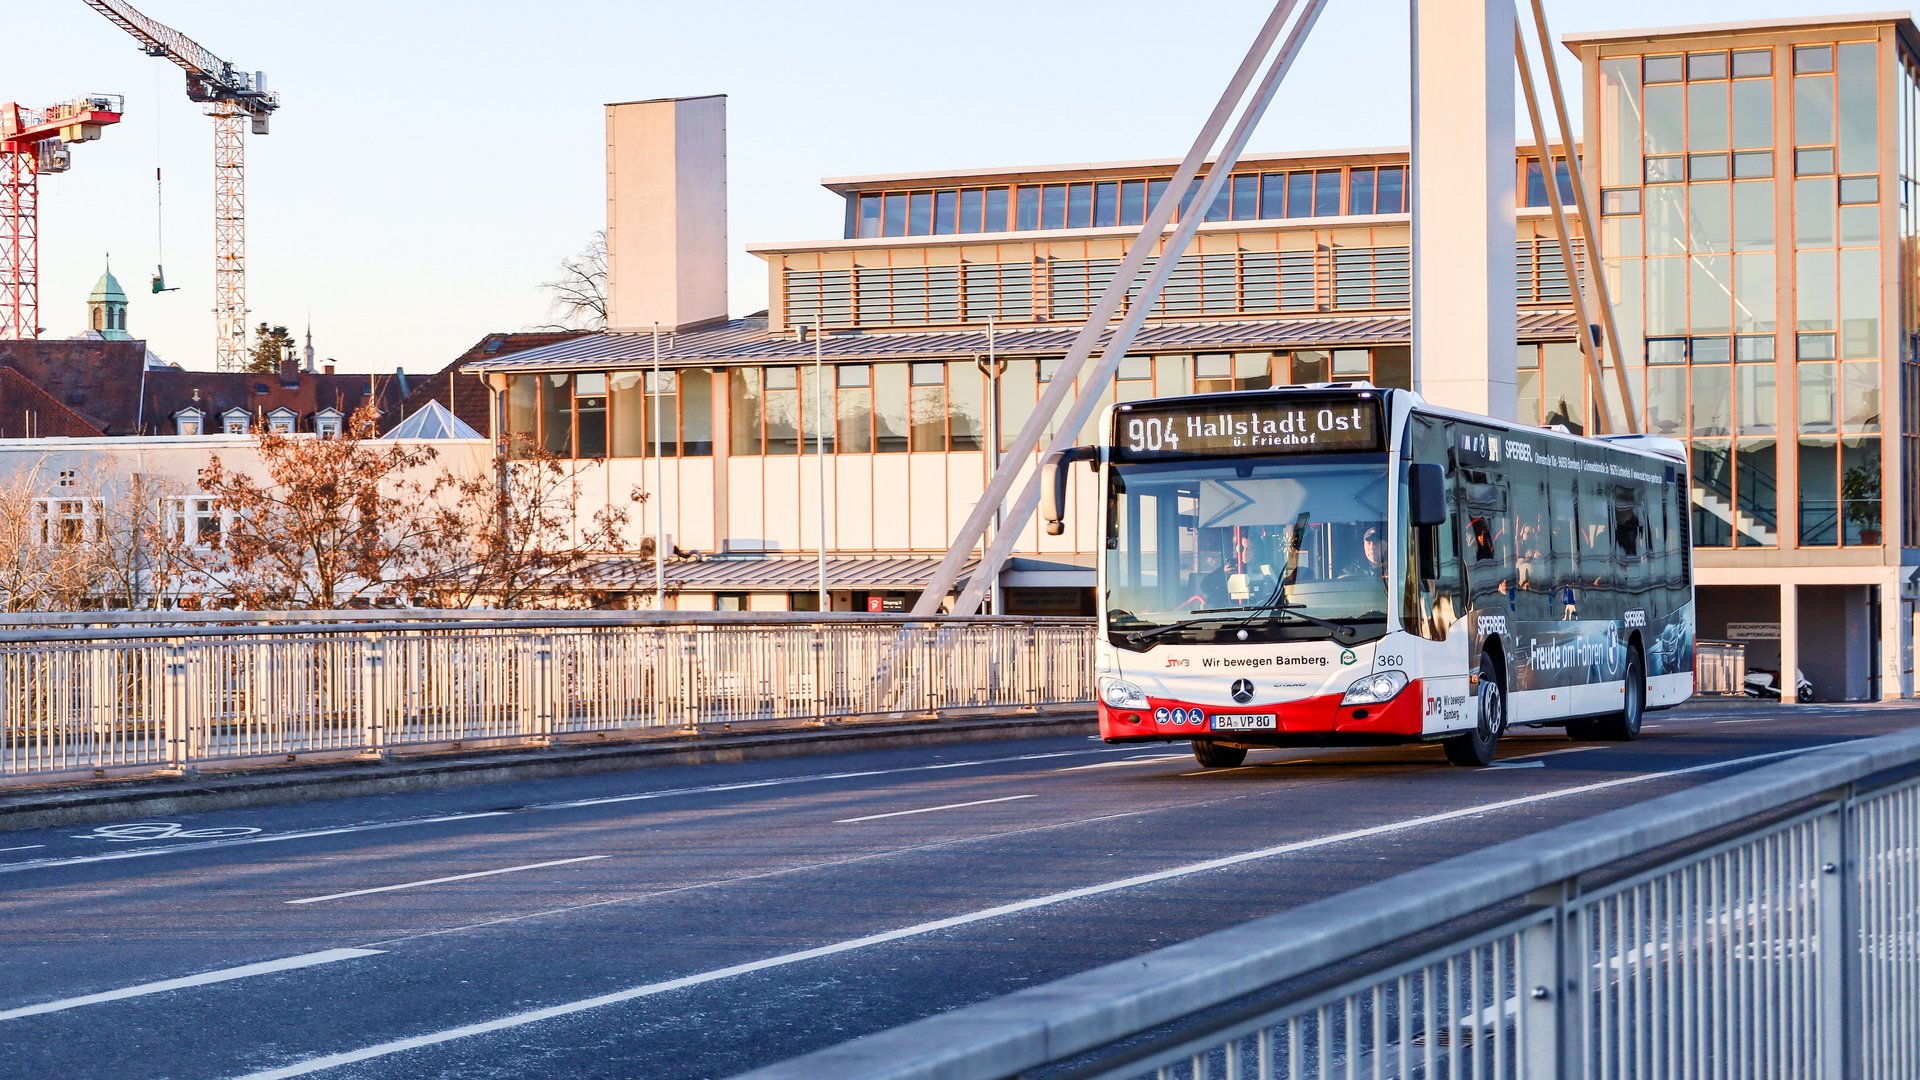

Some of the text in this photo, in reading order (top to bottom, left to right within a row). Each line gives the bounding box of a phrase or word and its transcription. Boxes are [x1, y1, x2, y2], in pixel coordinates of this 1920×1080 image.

[1129, 408, 1362, 452] 904 Hallstadt Ost
[1233, 432, 1316, 447] ü. Friedhof
[1505, 440, 1533, 463] SPERBER
[1477, 615, 1507, 636] SPERBER
[1624, 610, 1646, 626] SPERBER
[1378, 655, 1404, 666] 360
[1530, 635, 1603, 671] Freude am Fahren
[1202, 658, 1220, 667] Wir
[1224, 658, 1272, 668] bewegen
[1276, 656, 1329, 666] Bamberg.
[1450, 695, 1466, 706] bewegen
[1218, 716, 1270, 727] BA VP 80
